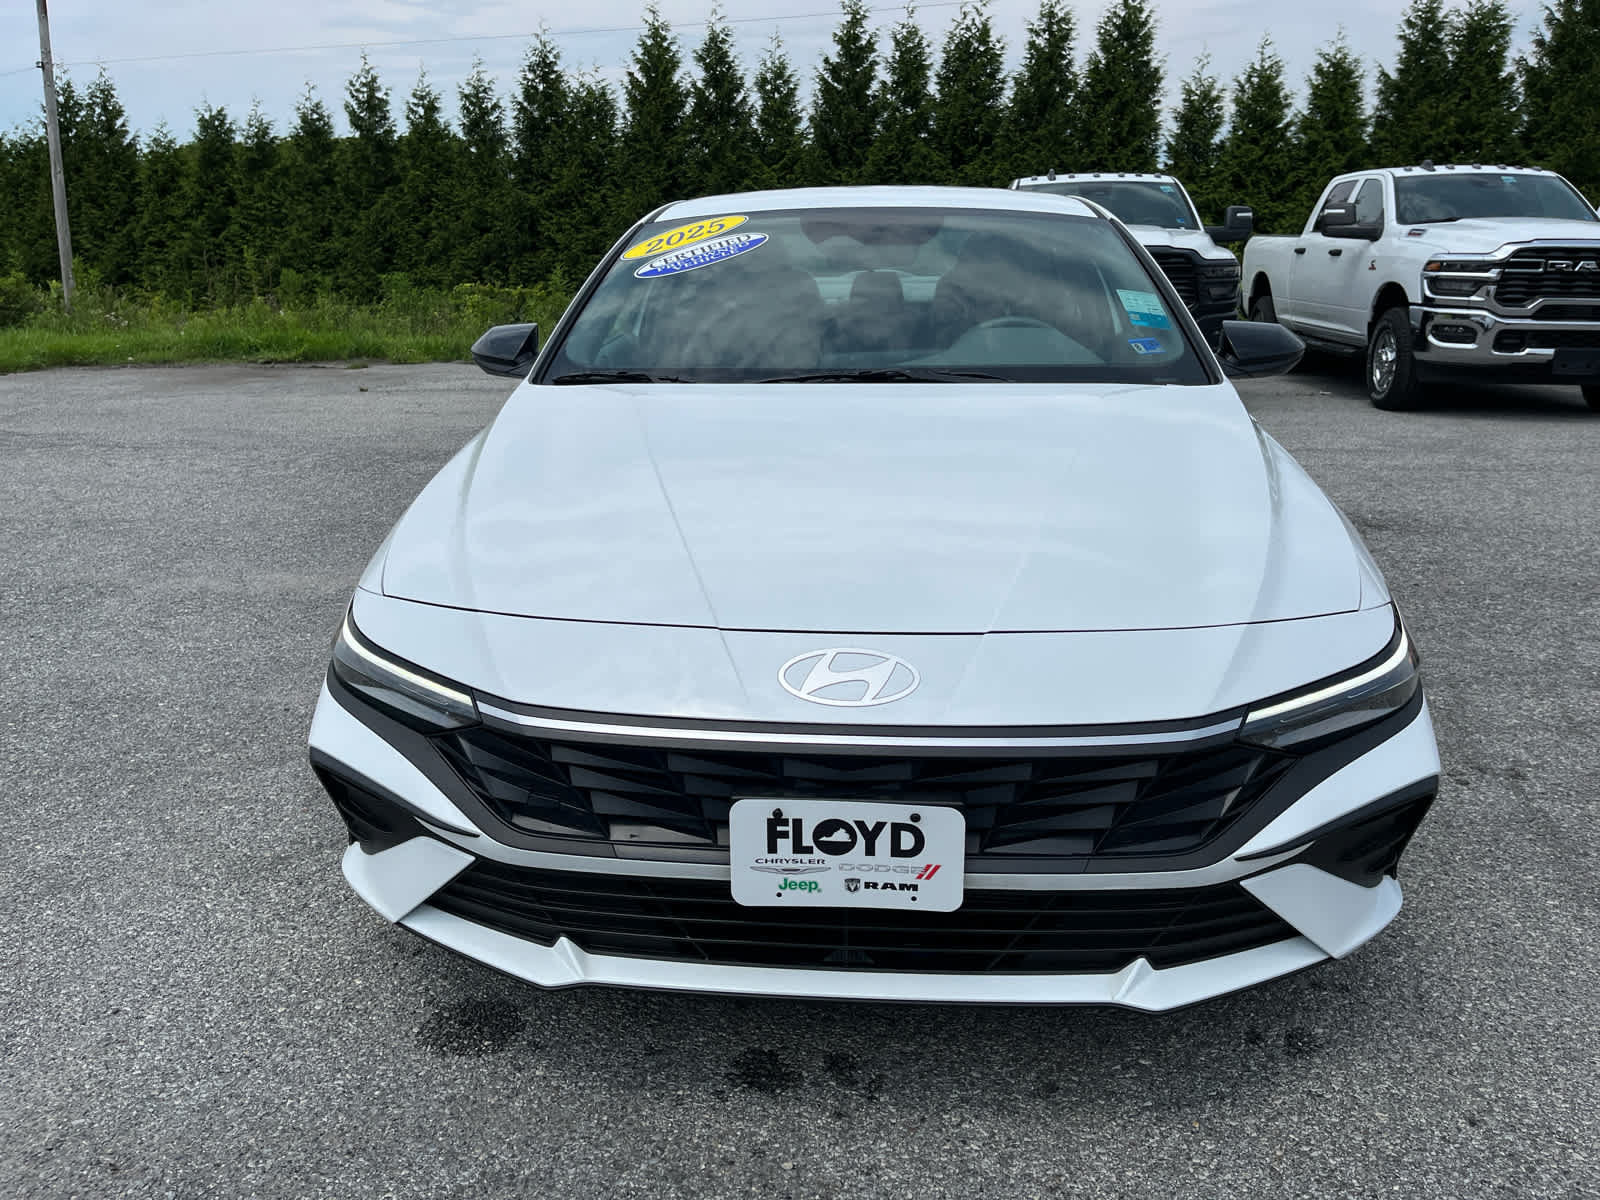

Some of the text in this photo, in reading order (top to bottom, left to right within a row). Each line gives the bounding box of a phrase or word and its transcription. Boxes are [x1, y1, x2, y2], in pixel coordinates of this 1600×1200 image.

[647, 219, 726, 254] 2025
[650, 234, 752, 269] CERTIFIED
[1546, 260, 1600, 272] RA
[766, 818, 925, 858] FLOYD
[838, 863, 925, 875] DODGE
[778, 878, 819, 893] Jeep
[864, 881, 919, 892] RAM
